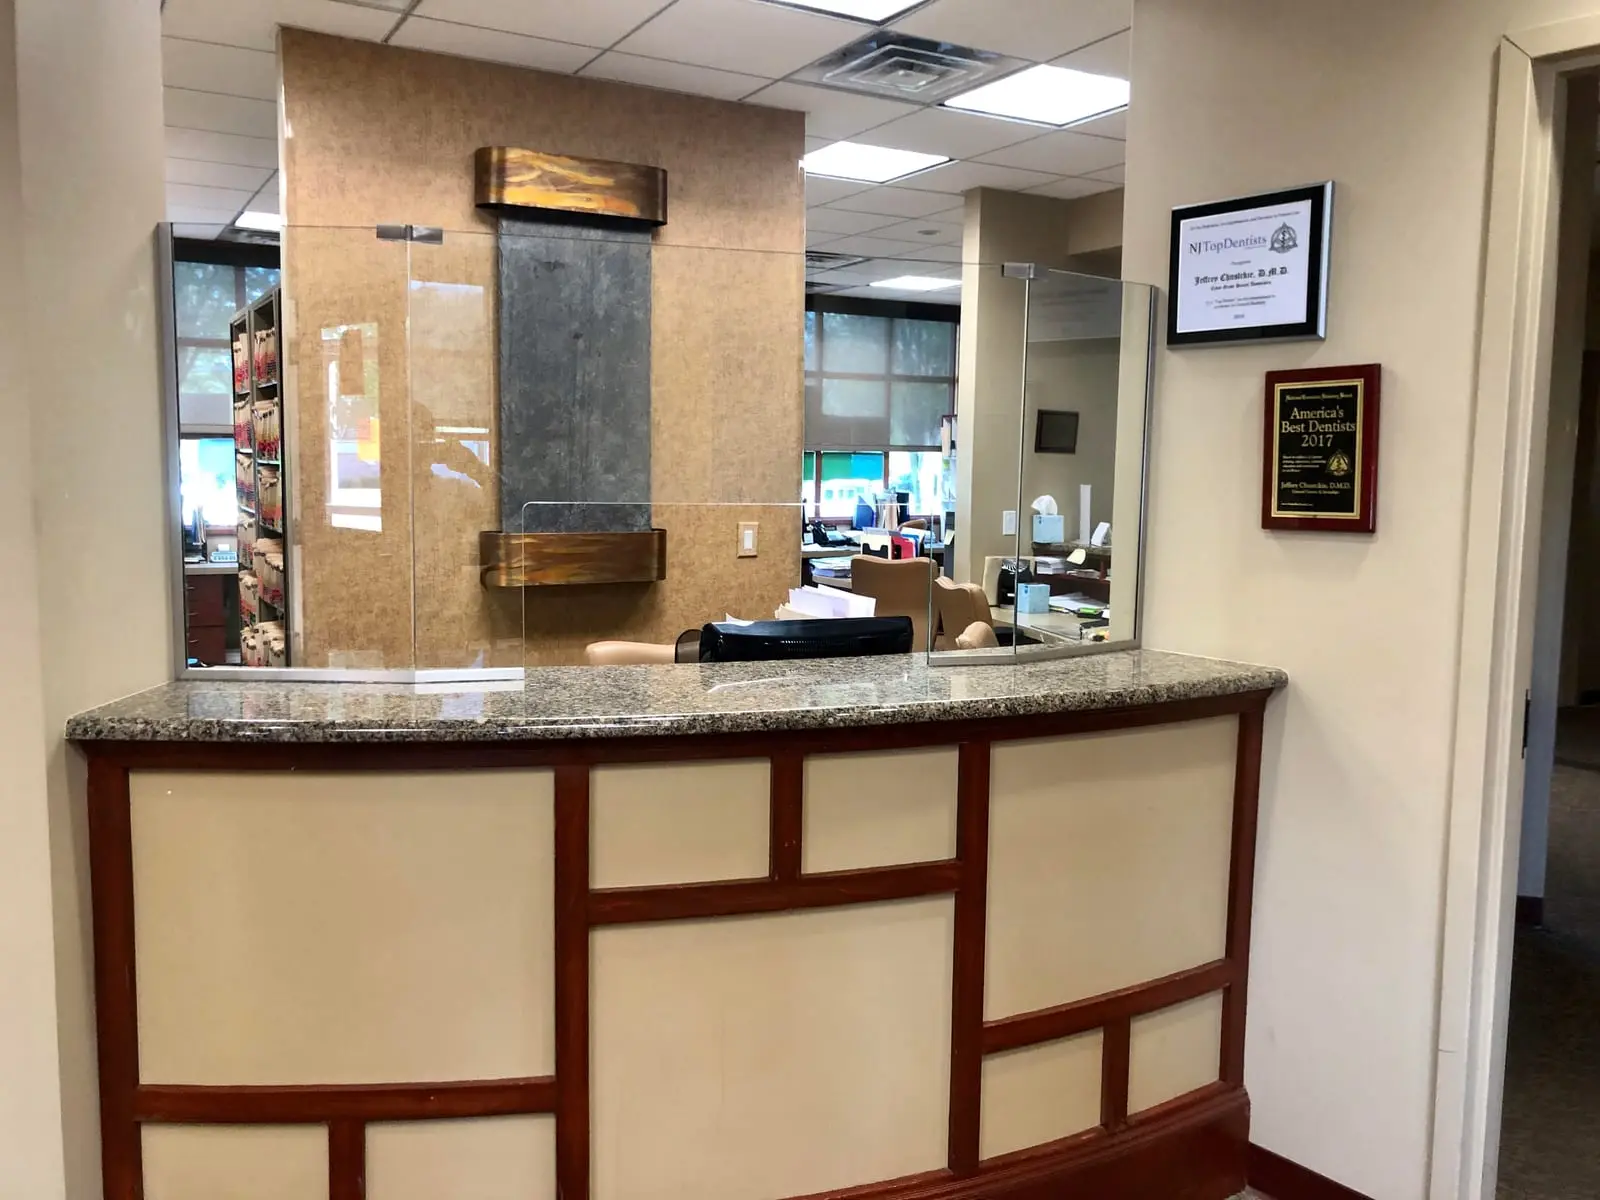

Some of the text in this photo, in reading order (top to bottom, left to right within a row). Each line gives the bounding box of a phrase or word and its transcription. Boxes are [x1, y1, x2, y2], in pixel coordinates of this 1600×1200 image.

[1194, 276, 1218, 286] Jeffrey
[1290, 405, 1344, 419] America's
[1281, 419, 1356, 433] Best Dentists
[1301, 434, 1334, 447] 2017
